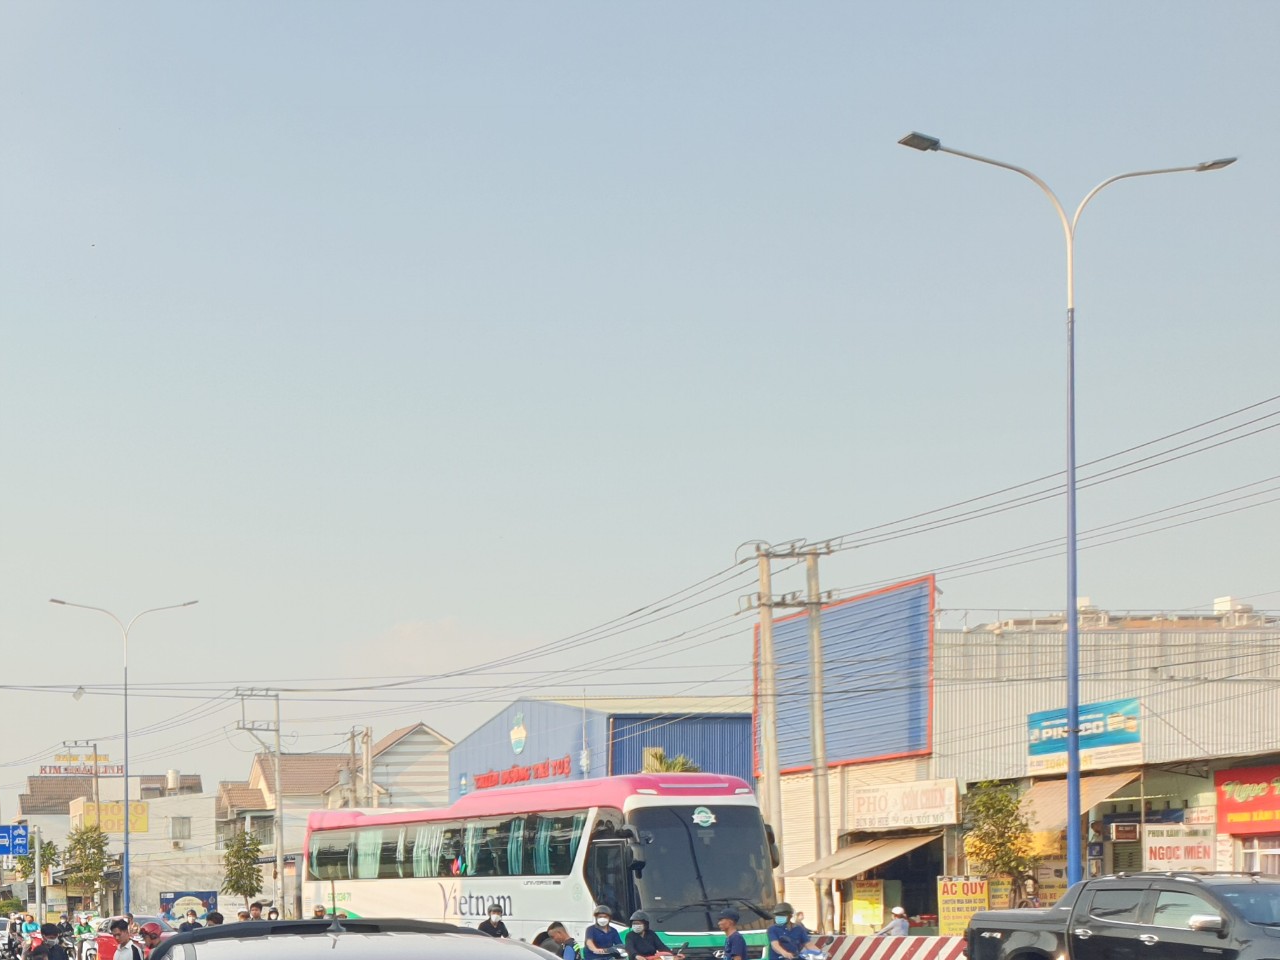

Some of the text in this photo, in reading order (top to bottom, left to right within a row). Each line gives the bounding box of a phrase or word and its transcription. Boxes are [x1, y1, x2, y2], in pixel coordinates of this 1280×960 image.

[40, 765, 62, 775] KIM
[85, 803, 147, 817] PHOO
[856, 792, 888, 814] PHỞ
[1149, 845, 1181, 863] NGỌC
[438, 881, 513, 919] Vietnam
